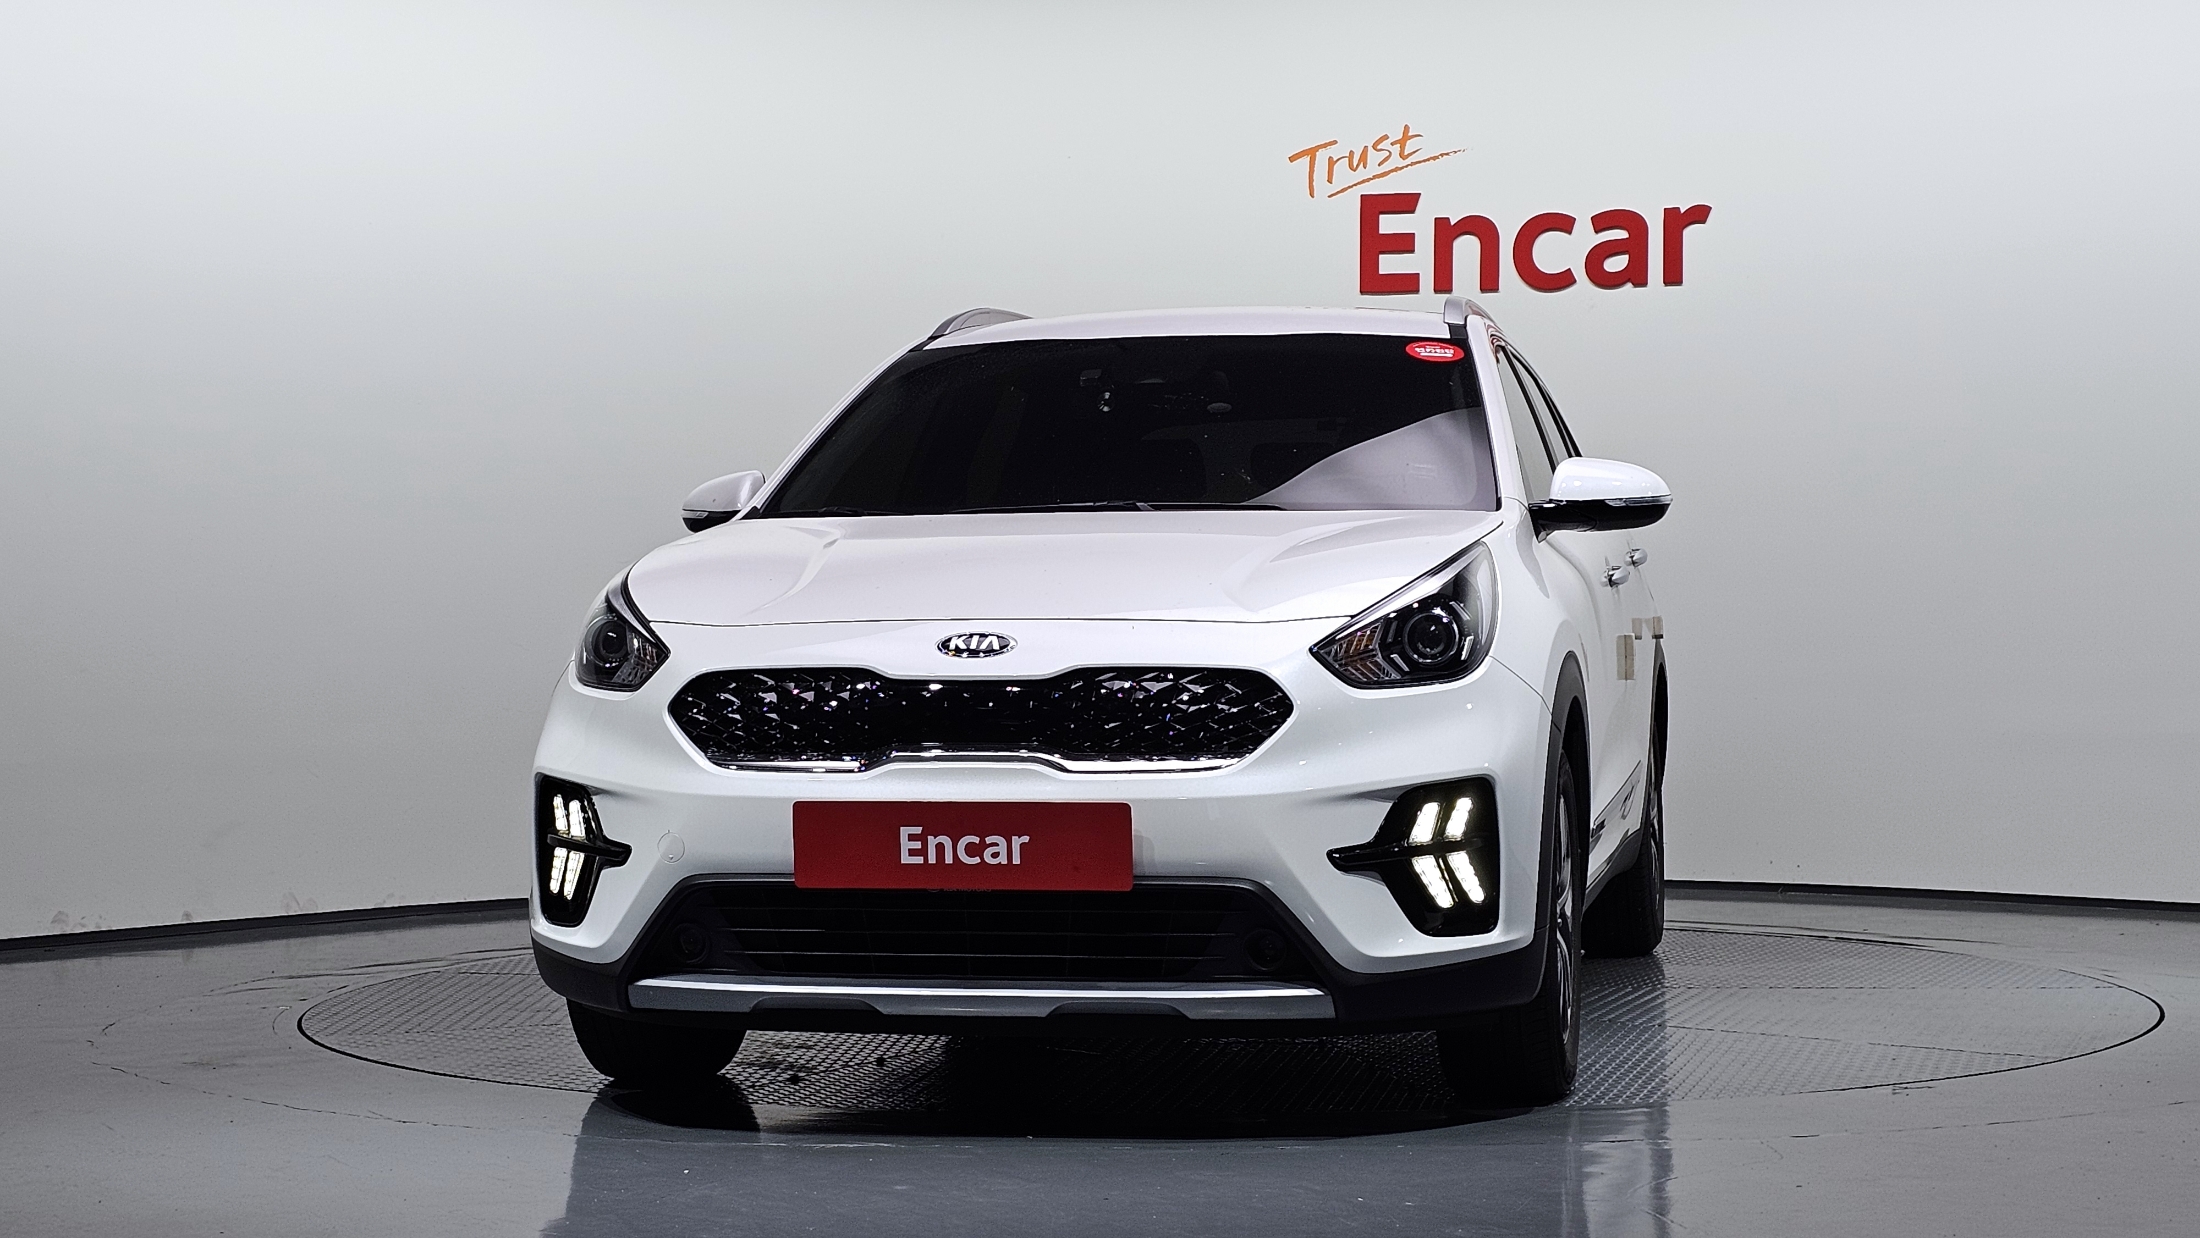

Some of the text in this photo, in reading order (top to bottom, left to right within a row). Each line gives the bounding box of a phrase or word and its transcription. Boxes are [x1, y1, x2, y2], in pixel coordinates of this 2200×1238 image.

[1288, 124, 1424, 198] Trust
[1359, 193, 1712, 295] Encar
[948, 634, 1000, 650] KIA
[899, 826, 1030, 865] Encar
